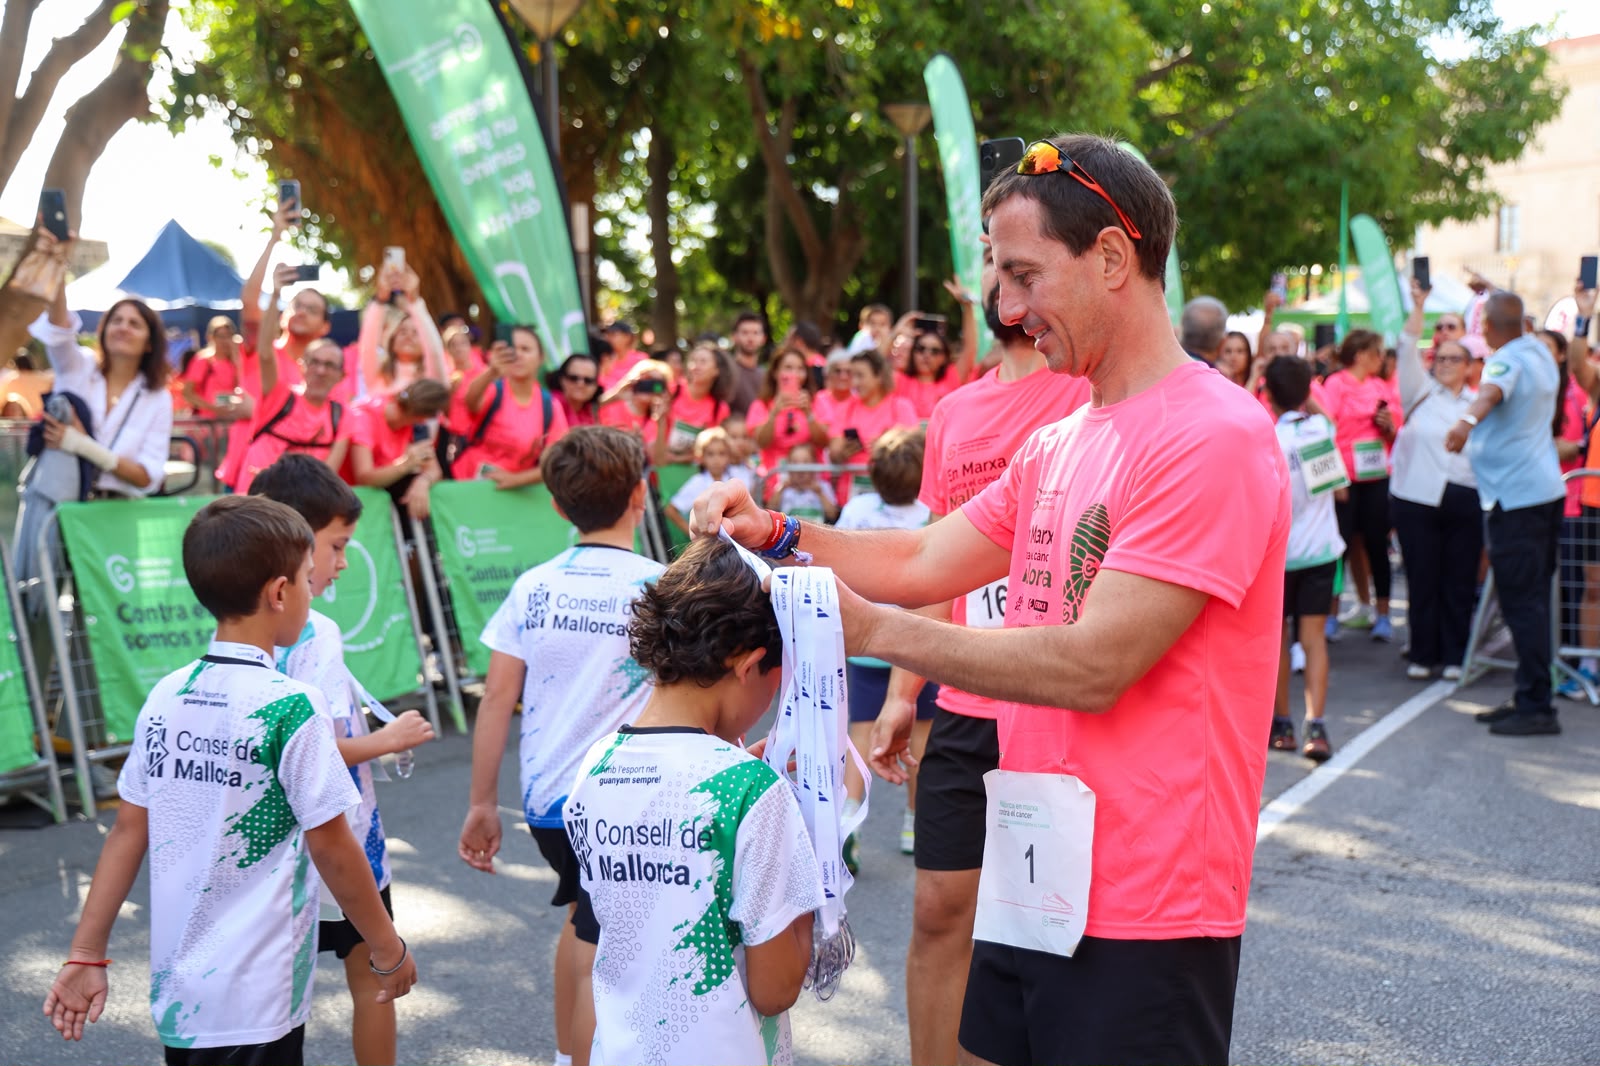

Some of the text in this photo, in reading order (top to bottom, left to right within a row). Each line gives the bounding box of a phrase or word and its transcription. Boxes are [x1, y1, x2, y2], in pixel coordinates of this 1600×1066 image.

[962, 457, 1007, 477] Marxa
[977, 474, 1001, 484] cànc
[1030, 525, 1054, 545] Marx
[1033, 550, 1049, 562] cànc
[117, 602, 188, 624] Contra
[556, 593, 618, 614] Consell
[553, 614, 626, 637] Mallorca
[124, 631, 192, 651] somos
[177, 730, 261, 763] Conse de
[618, 765, 645, 775] l'esport
[599, 775, 662, 787] guanyam sempre!
[595, 818, 713, 850] Consell de
[599, 854, 690, 886] Mallorca
[1025, 844, 1035, 884] 1
